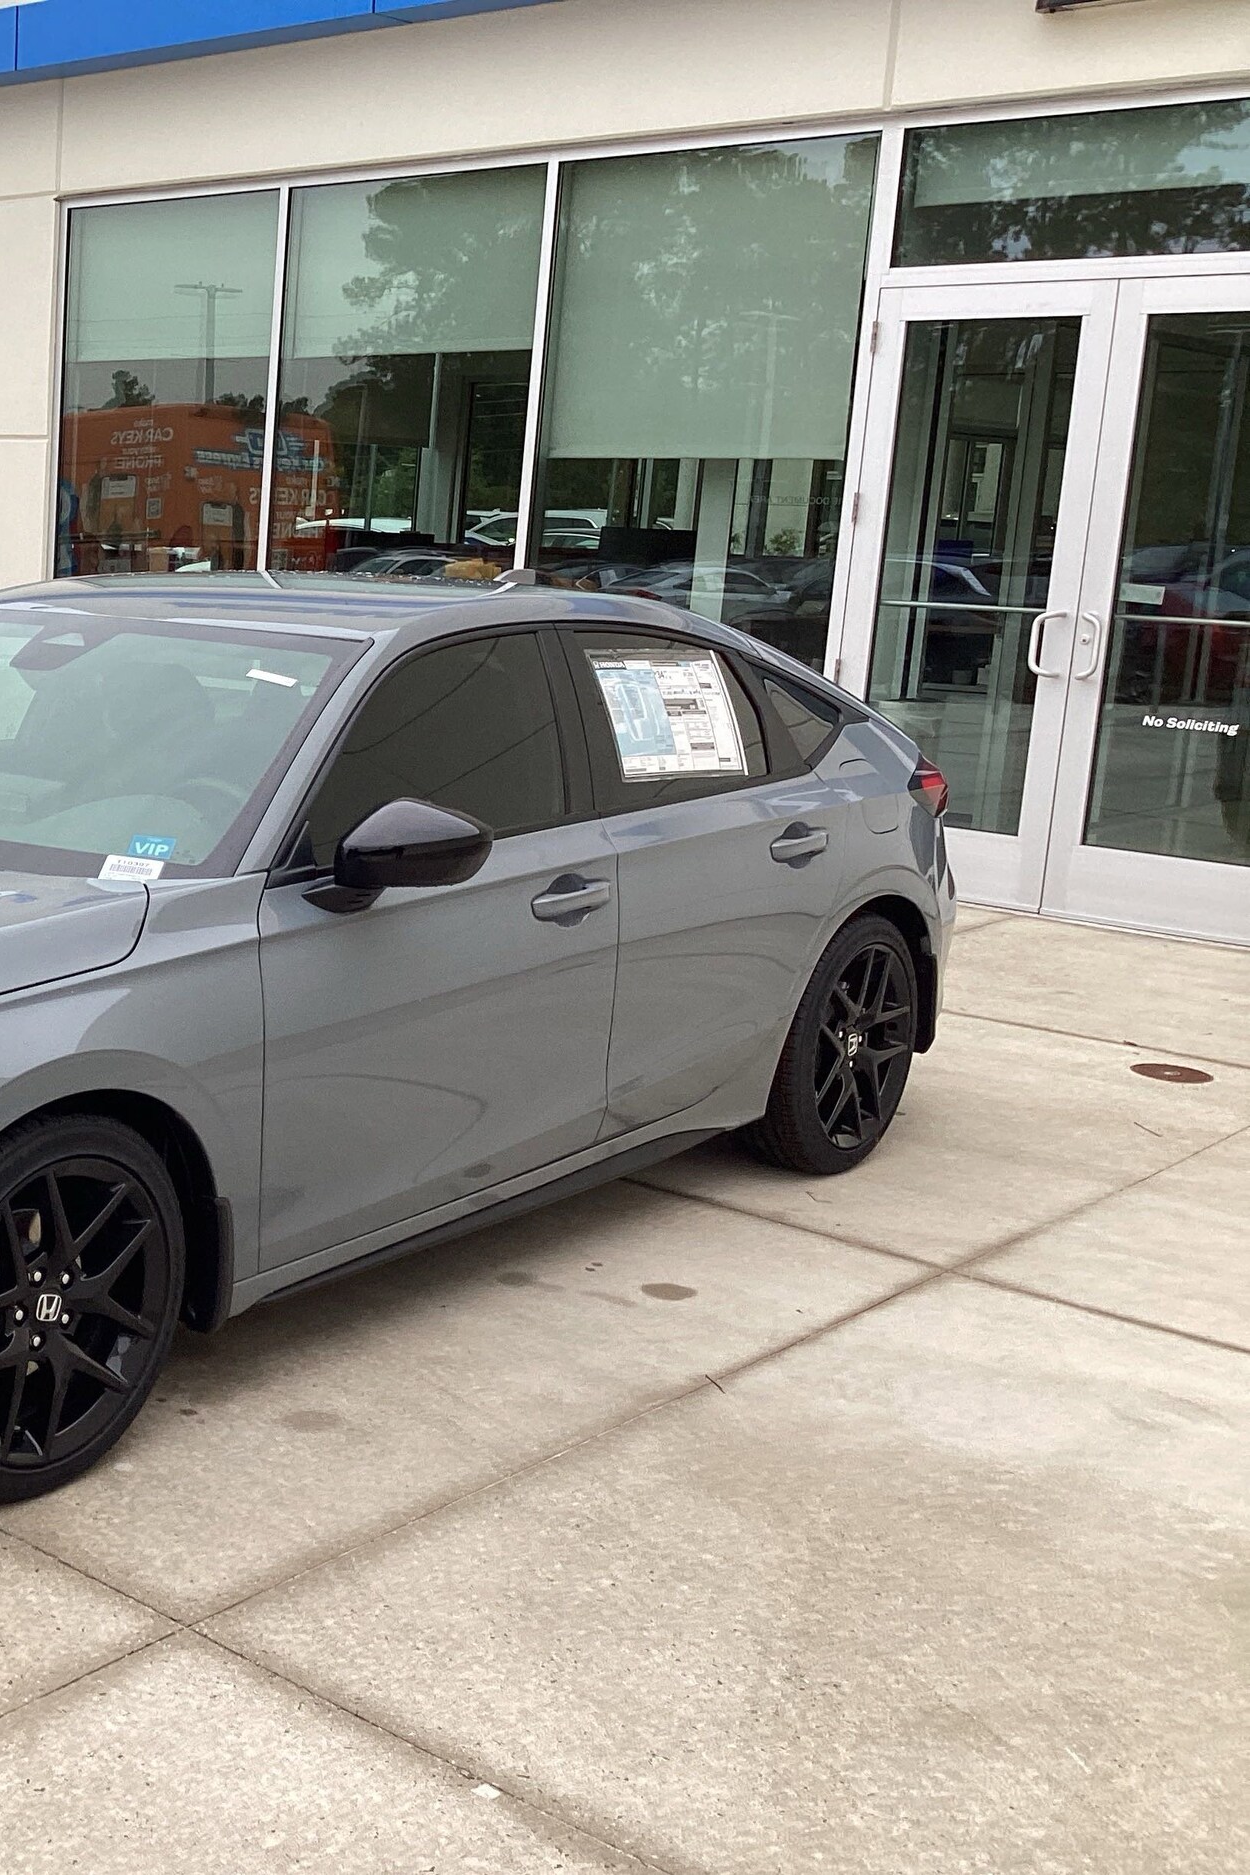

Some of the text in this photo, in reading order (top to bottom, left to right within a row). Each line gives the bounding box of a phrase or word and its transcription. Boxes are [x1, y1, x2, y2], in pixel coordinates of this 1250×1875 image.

[1142, 715, 1240, 736] No Soliciting
[135, 842, 169, 856] VIP
